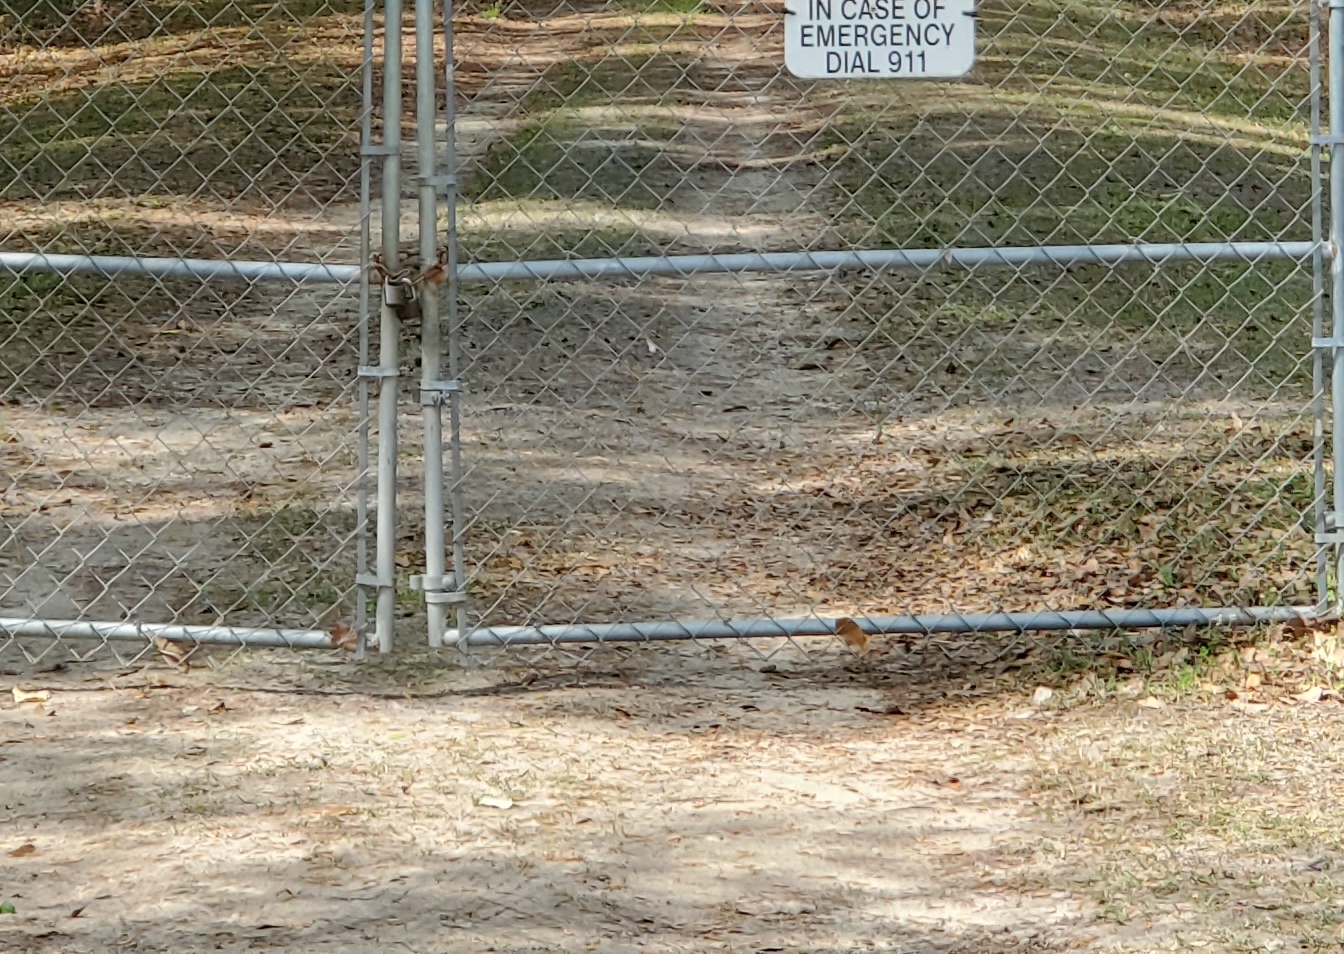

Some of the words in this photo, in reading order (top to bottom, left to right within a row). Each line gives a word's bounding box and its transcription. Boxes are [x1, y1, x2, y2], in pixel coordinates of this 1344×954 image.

[800, 23, 956, 47] EMERGENCY
[826, 51, 881, 74] DIAL
[888, 50, 927, 73] 911
